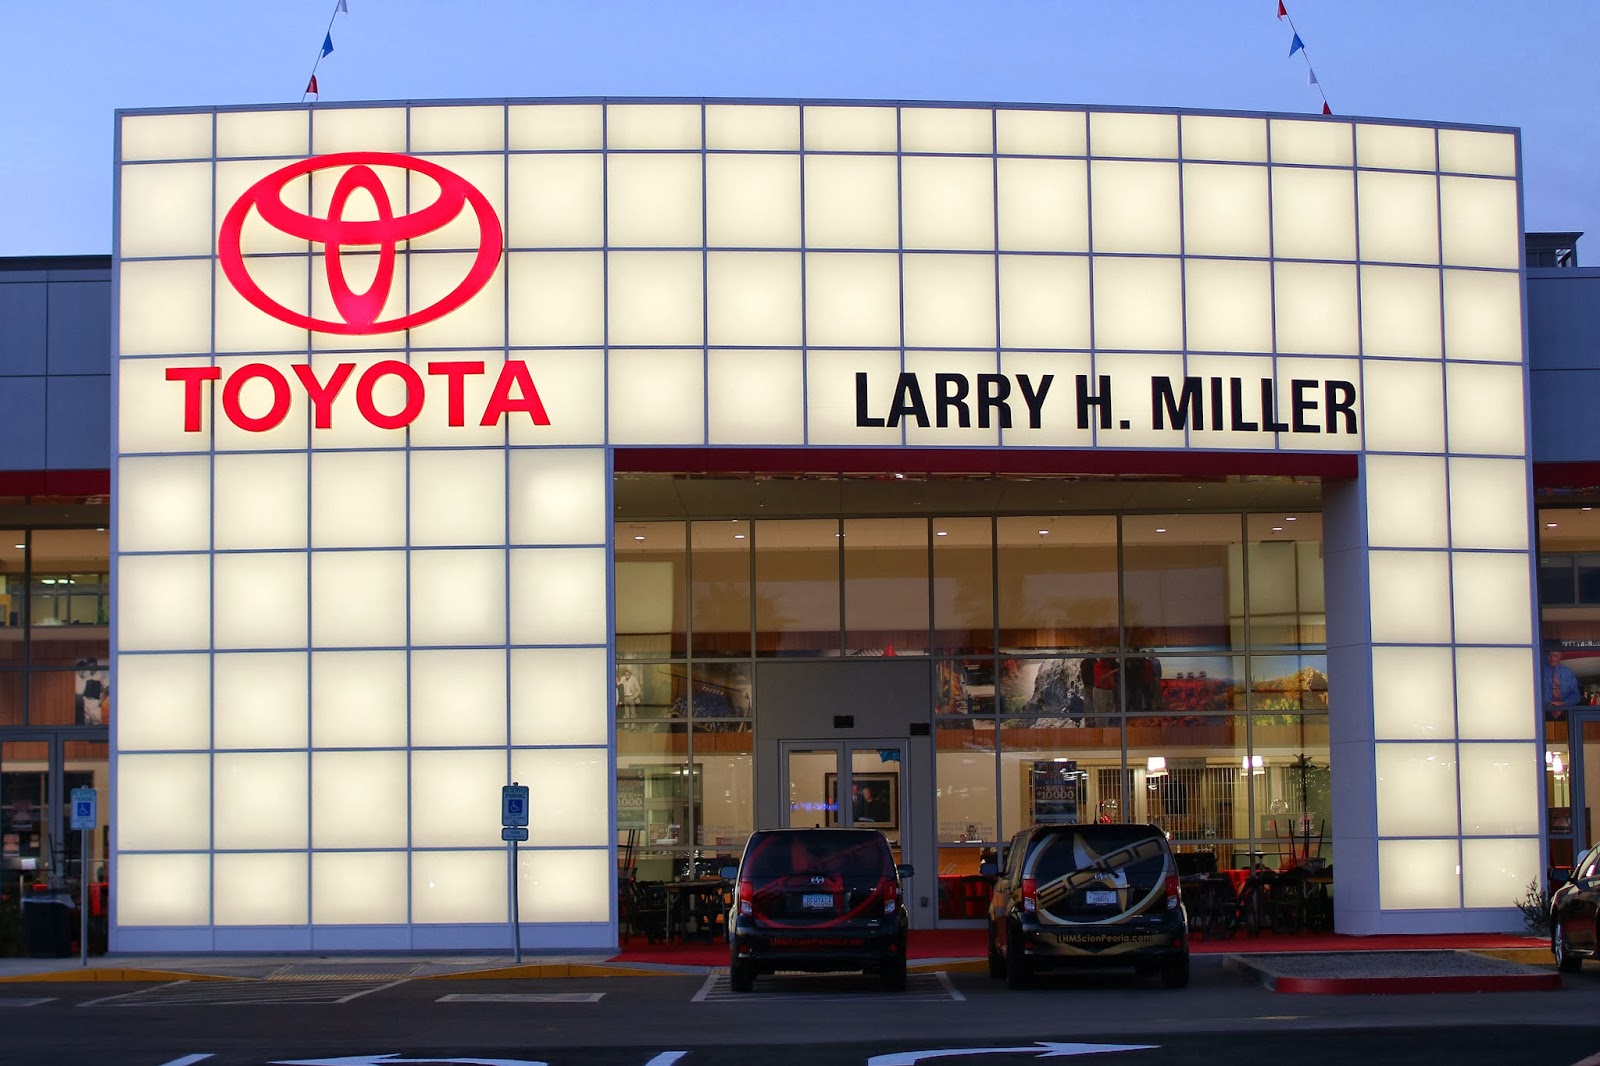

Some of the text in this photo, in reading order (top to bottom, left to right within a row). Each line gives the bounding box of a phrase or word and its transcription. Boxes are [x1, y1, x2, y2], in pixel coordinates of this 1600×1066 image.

[164, 359, 552, 433] TOYOTA
[855, 372, 1358, 434] LARRY H. MILLER
[1058, 933, 1153, 943] LHMScionPeoria.com
